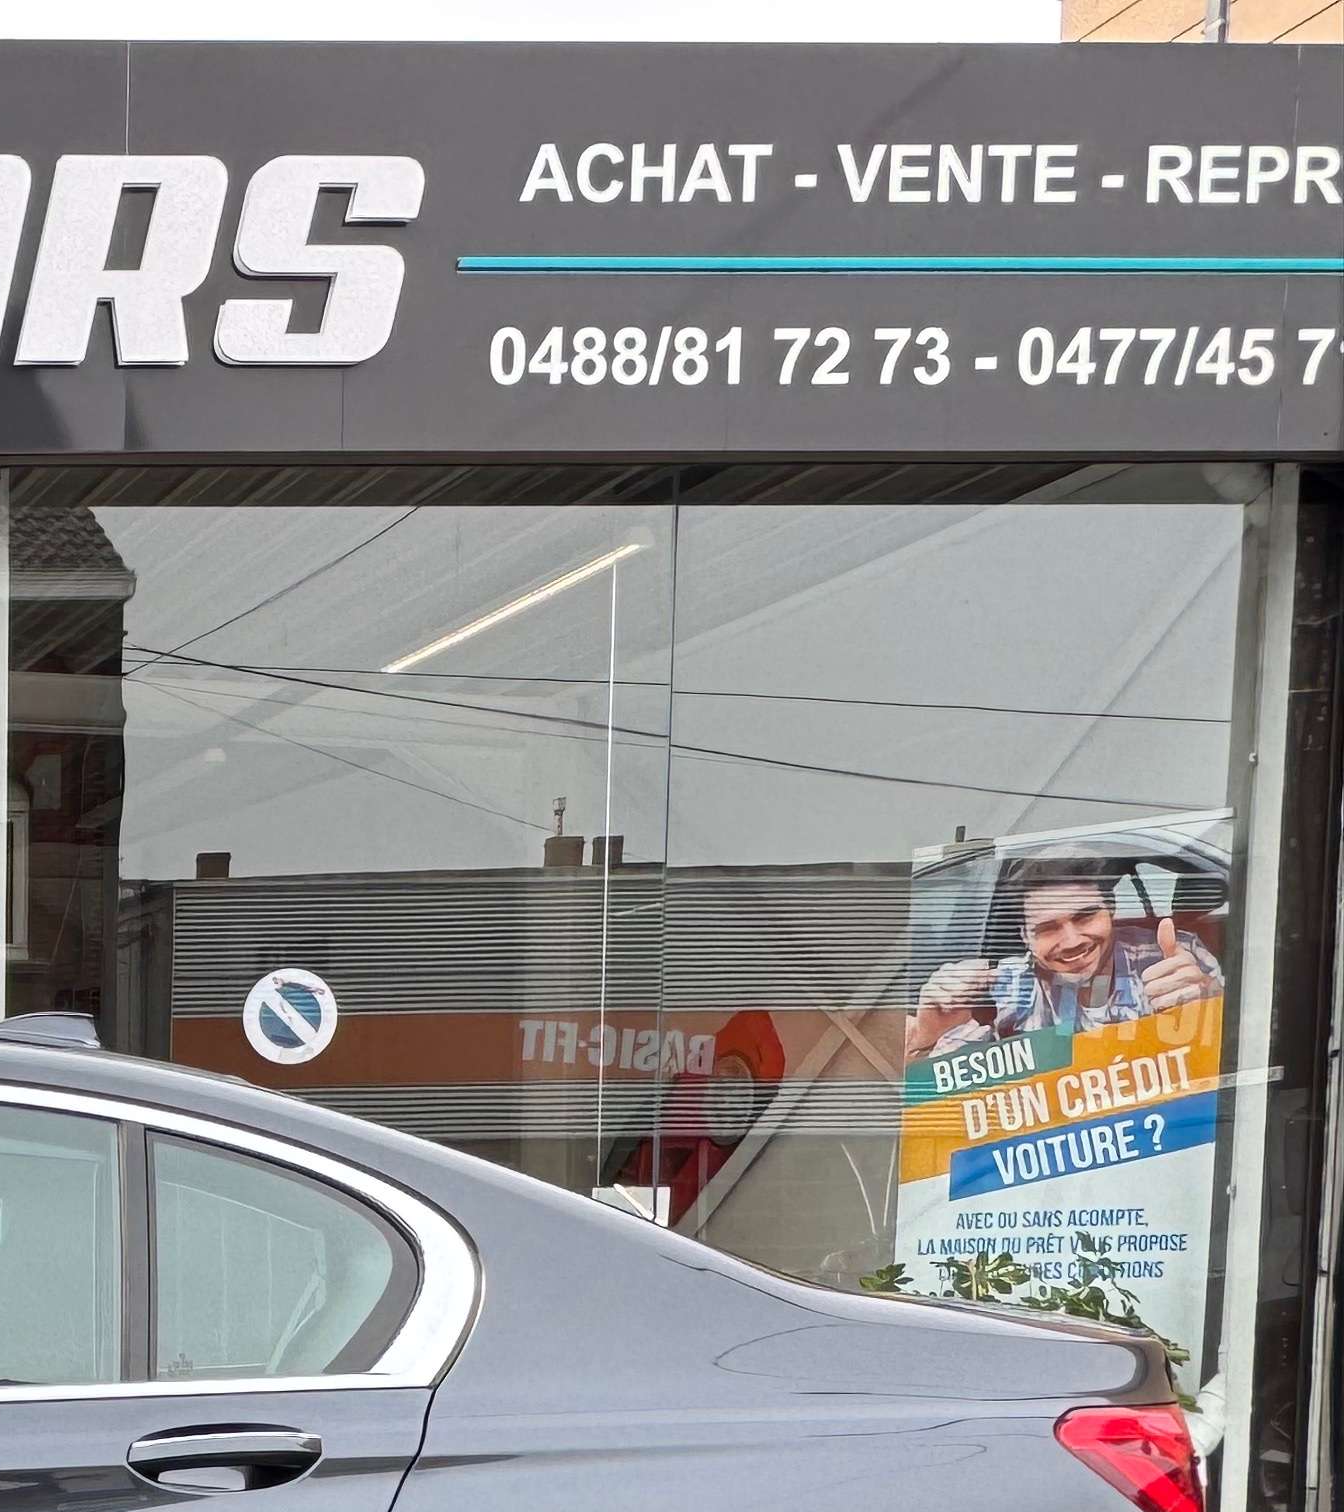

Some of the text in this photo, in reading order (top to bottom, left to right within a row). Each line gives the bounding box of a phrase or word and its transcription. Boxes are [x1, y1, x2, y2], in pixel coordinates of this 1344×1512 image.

[519, 143, 773, 202] ACHAT
[837, 143, 1079, 203] VENTE
[489, 326, 744, 386] 0488/81
[773, 328, 850, 385] 72
[874, 328, 952, 386] 73
[1018, 326, 1275, 386] 0477/45
[1297, 328, 1344, 385] 7
[932, 1037, 1036, 1094] BESOIN
[962, 1045, 1192, 1141] D'UN CRÉDIT
[992, 1112, 1166, 1187] VOITURE ?
[917, 1232, 1189, 1256] LA MAISON DU PRÊT VUS PROPOSE
[955, 1207, 1150, 1230] AVEC OU SANS ACOMPTE,
